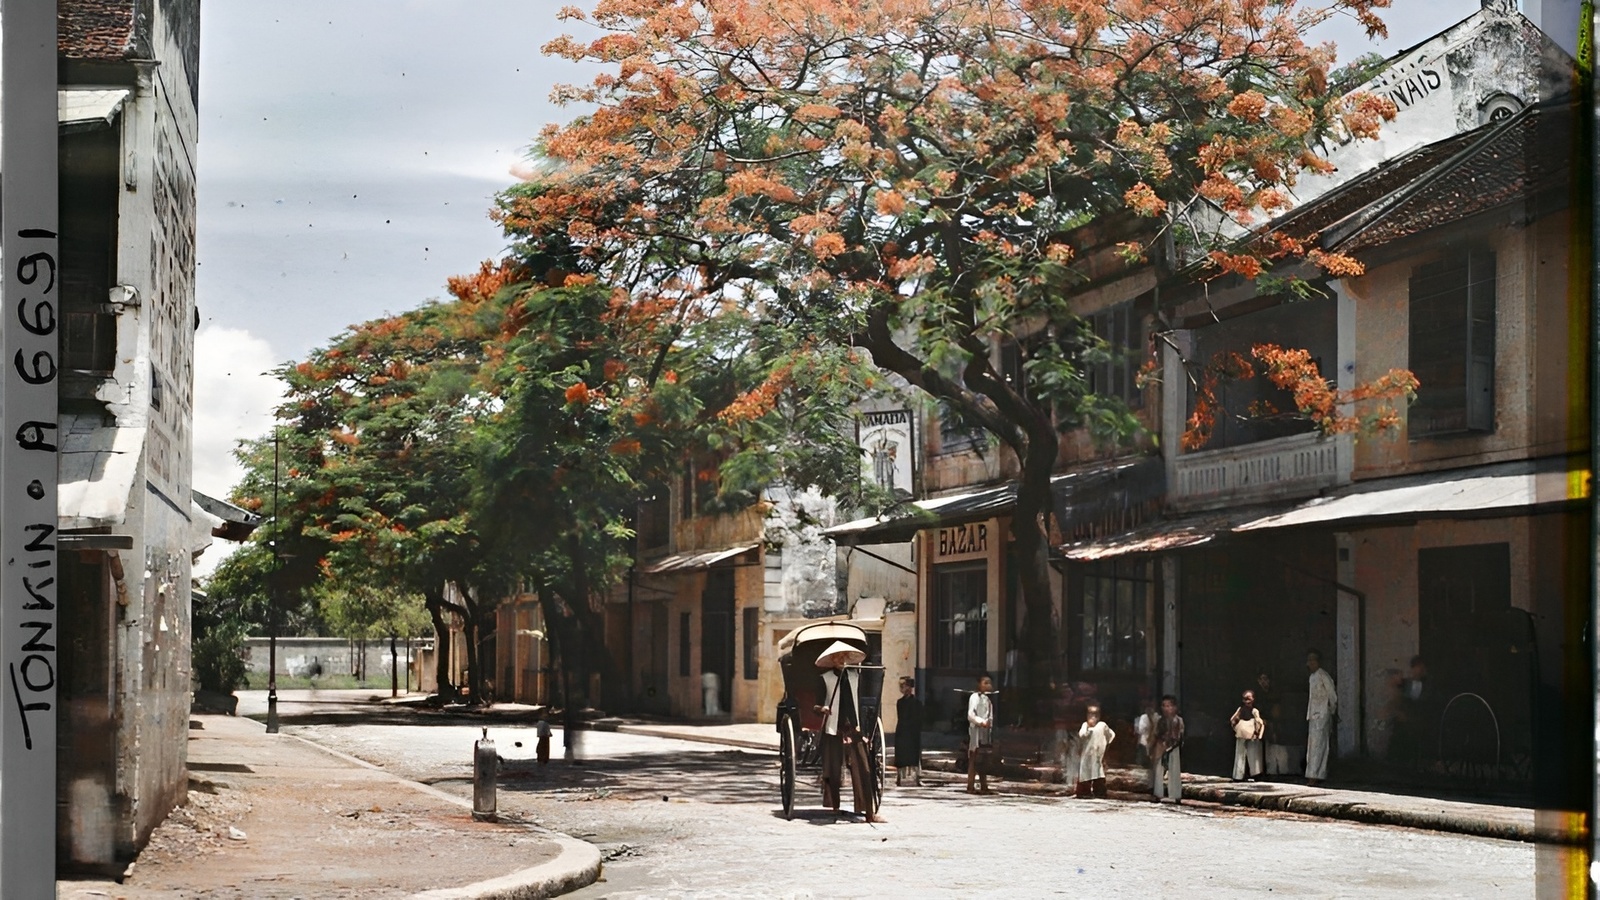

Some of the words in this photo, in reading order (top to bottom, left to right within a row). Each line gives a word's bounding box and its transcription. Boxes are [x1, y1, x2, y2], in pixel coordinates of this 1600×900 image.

[14, 228, 57, 385] 6691
[16, 421, 57, 452] A
[940, 524, 987, 556] BAZAR
